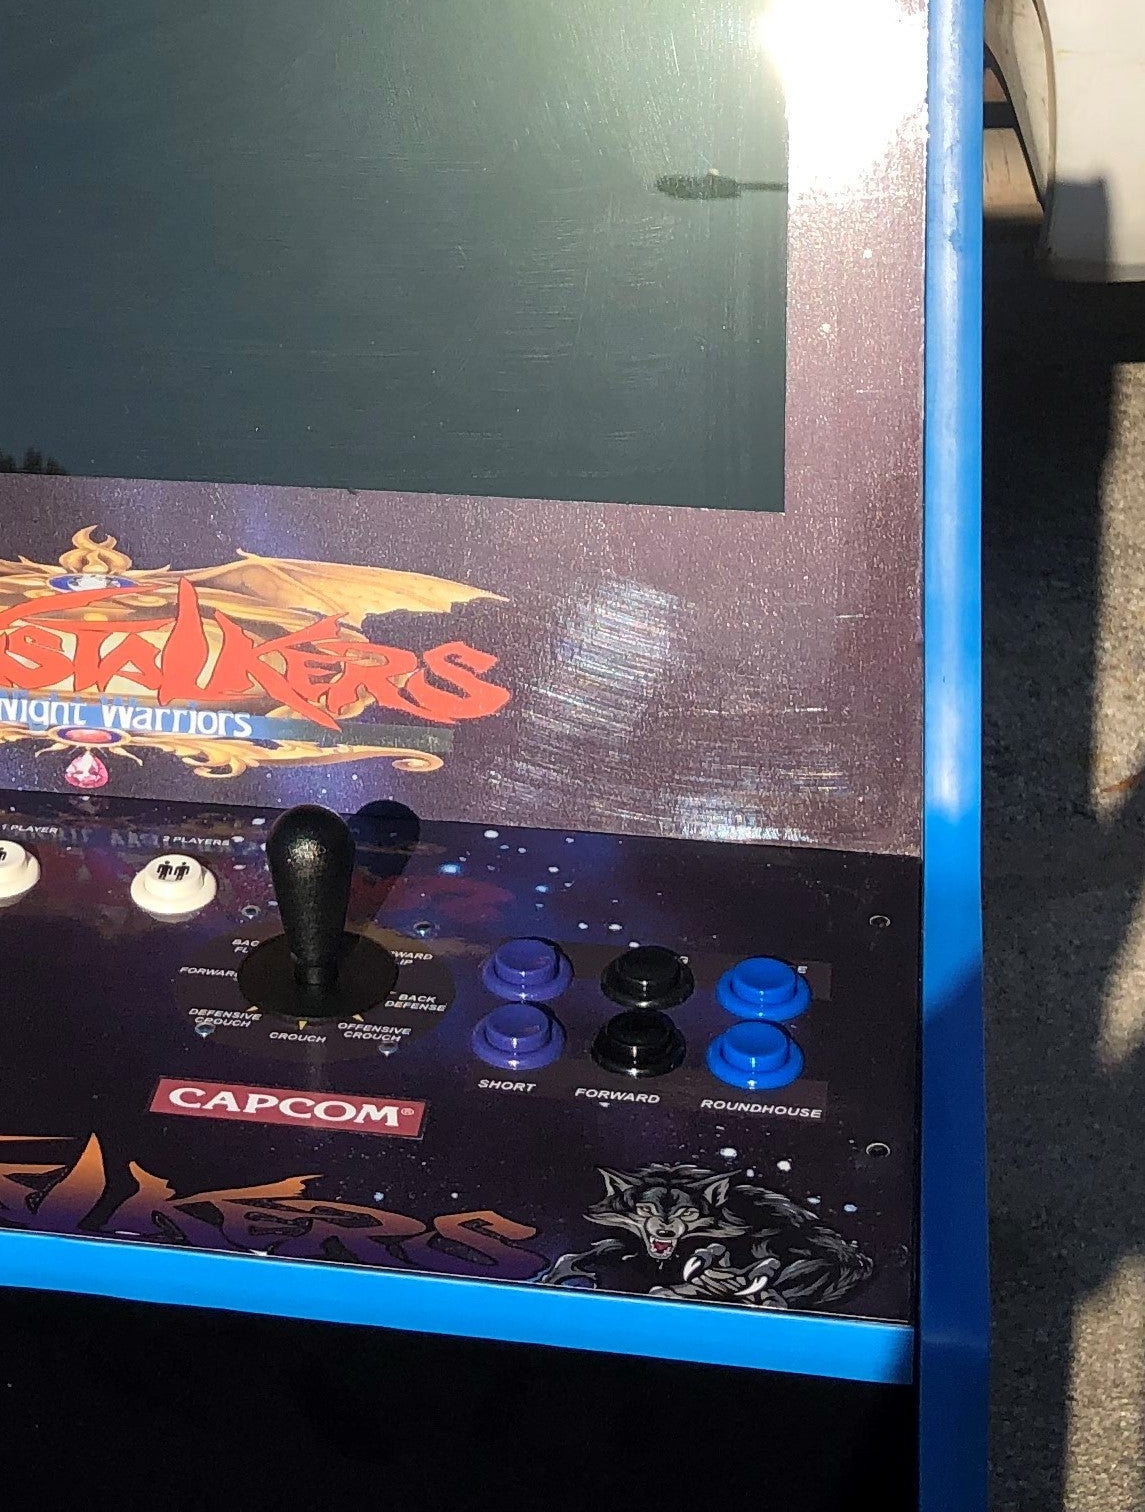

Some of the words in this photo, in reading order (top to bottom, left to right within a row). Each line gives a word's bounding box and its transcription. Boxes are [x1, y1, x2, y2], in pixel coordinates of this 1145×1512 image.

[98, 703, 253, 739] Warriors
[11, 824, 58, 834] PLAYER
[173, 836, 230, 846] PLAYERS
[398, 993, 437, 1003] BACK
[384, 1000, 447, 1012] DEFENSE
[188, 1008, 263, 1021] DEFENSIVE
[194, 1016, 252, 1028] CROUCH
[337, 1022, 412, 1035] OFFENSIVE
[269, 1031, 327, 1043] CROUCH
[343, 1030, 402, 1042] CROUCH
[477, 1078, 537, 1093] SHORT
[574, 1087, 661, 1104] FORWARD
[700, 1099, 823, 1119] ROUNDHOUSE
